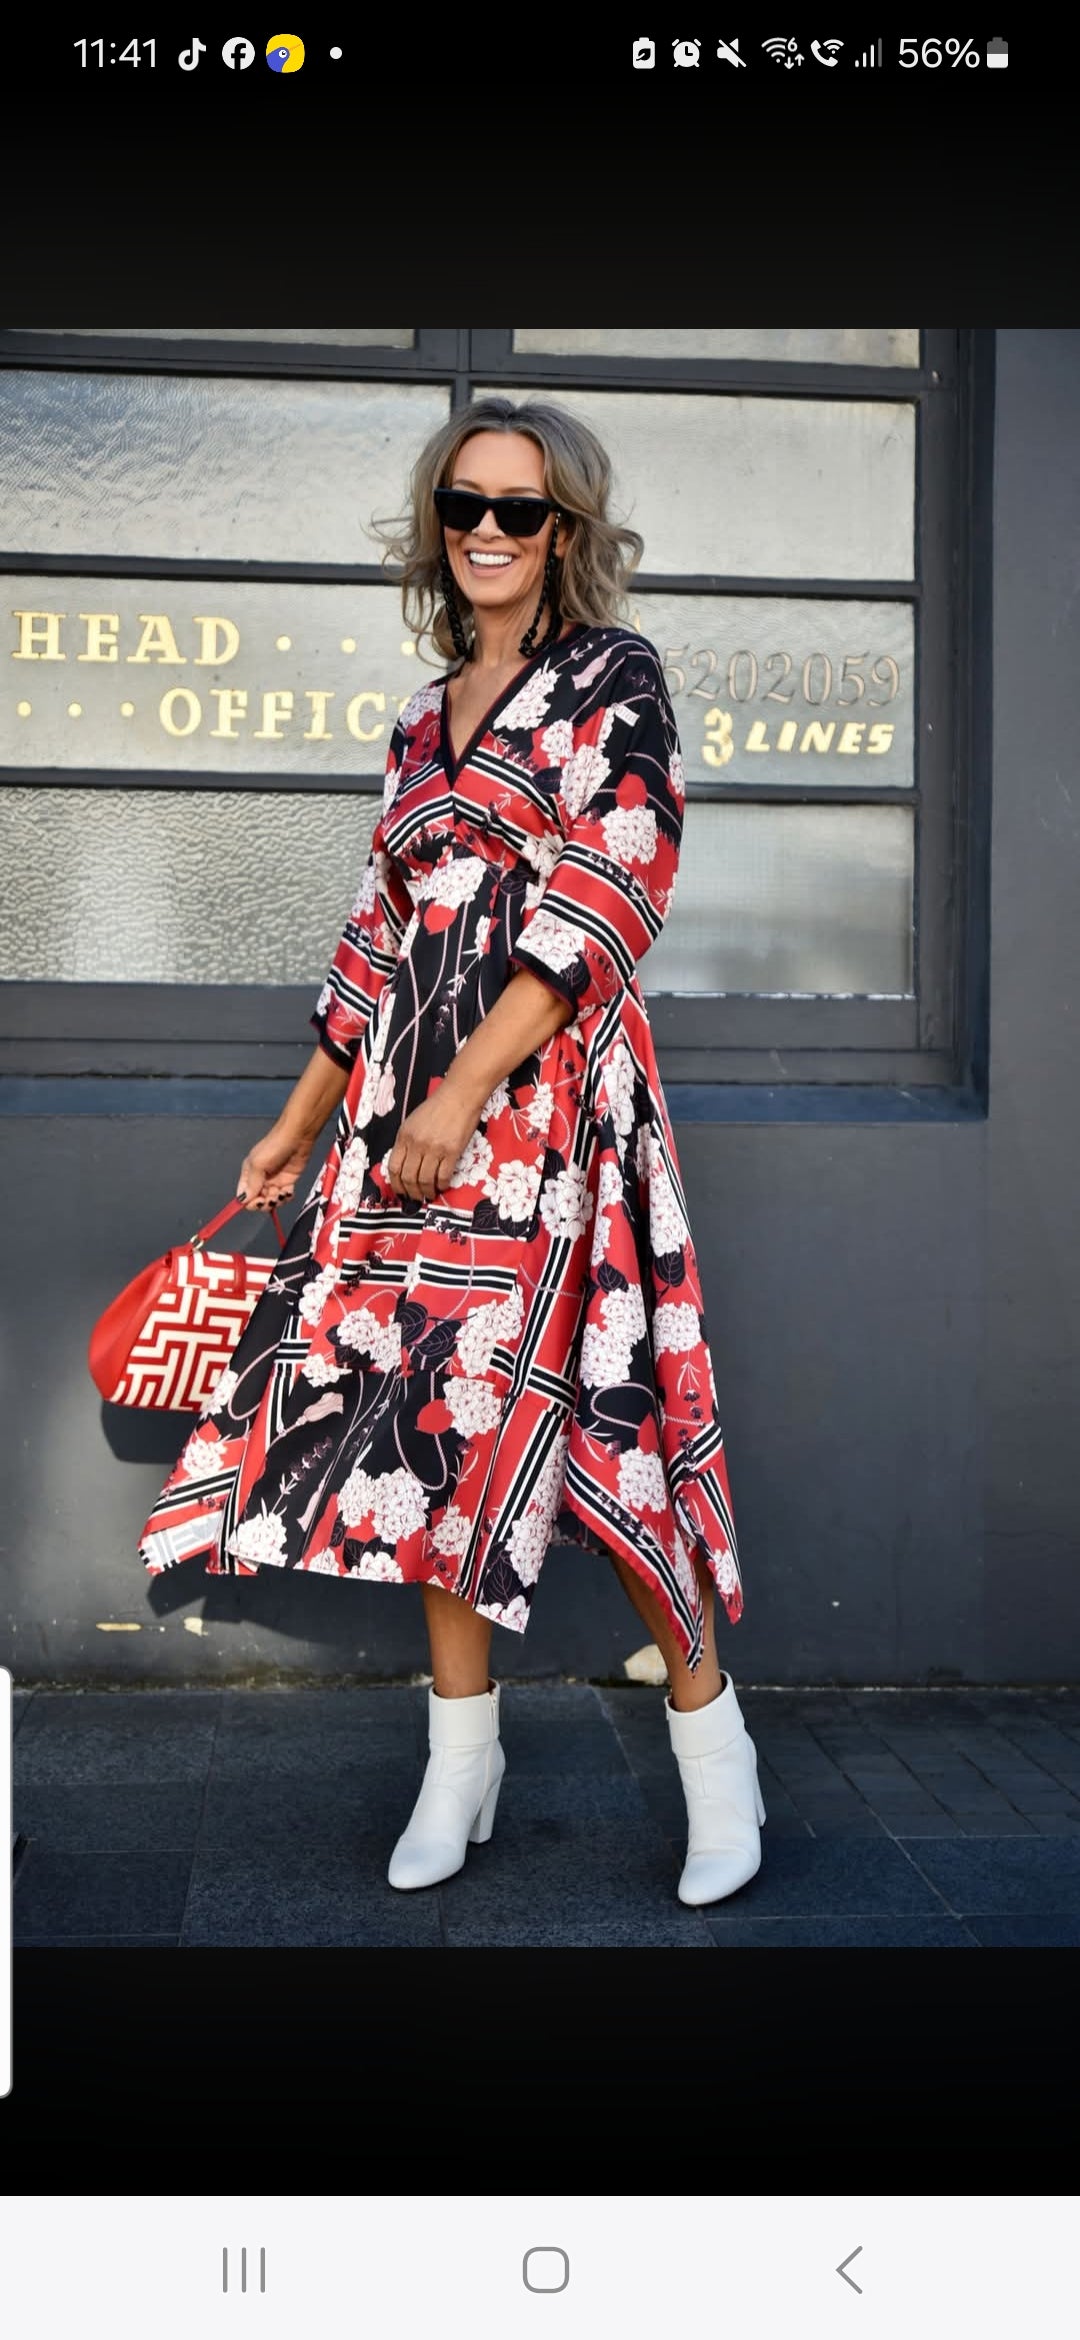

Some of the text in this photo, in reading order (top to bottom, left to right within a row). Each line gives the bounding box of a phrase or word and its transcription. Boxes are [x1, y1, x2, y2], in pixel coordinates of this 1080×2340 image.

[73, 38, 156, 68] 11:41
[898, 37, 981, 69] 56%
[12, 611, 240, 666] HEAD
[159, 687, 410, 741] OFFIC
[702, 707, 895, 768] 3 LINES
